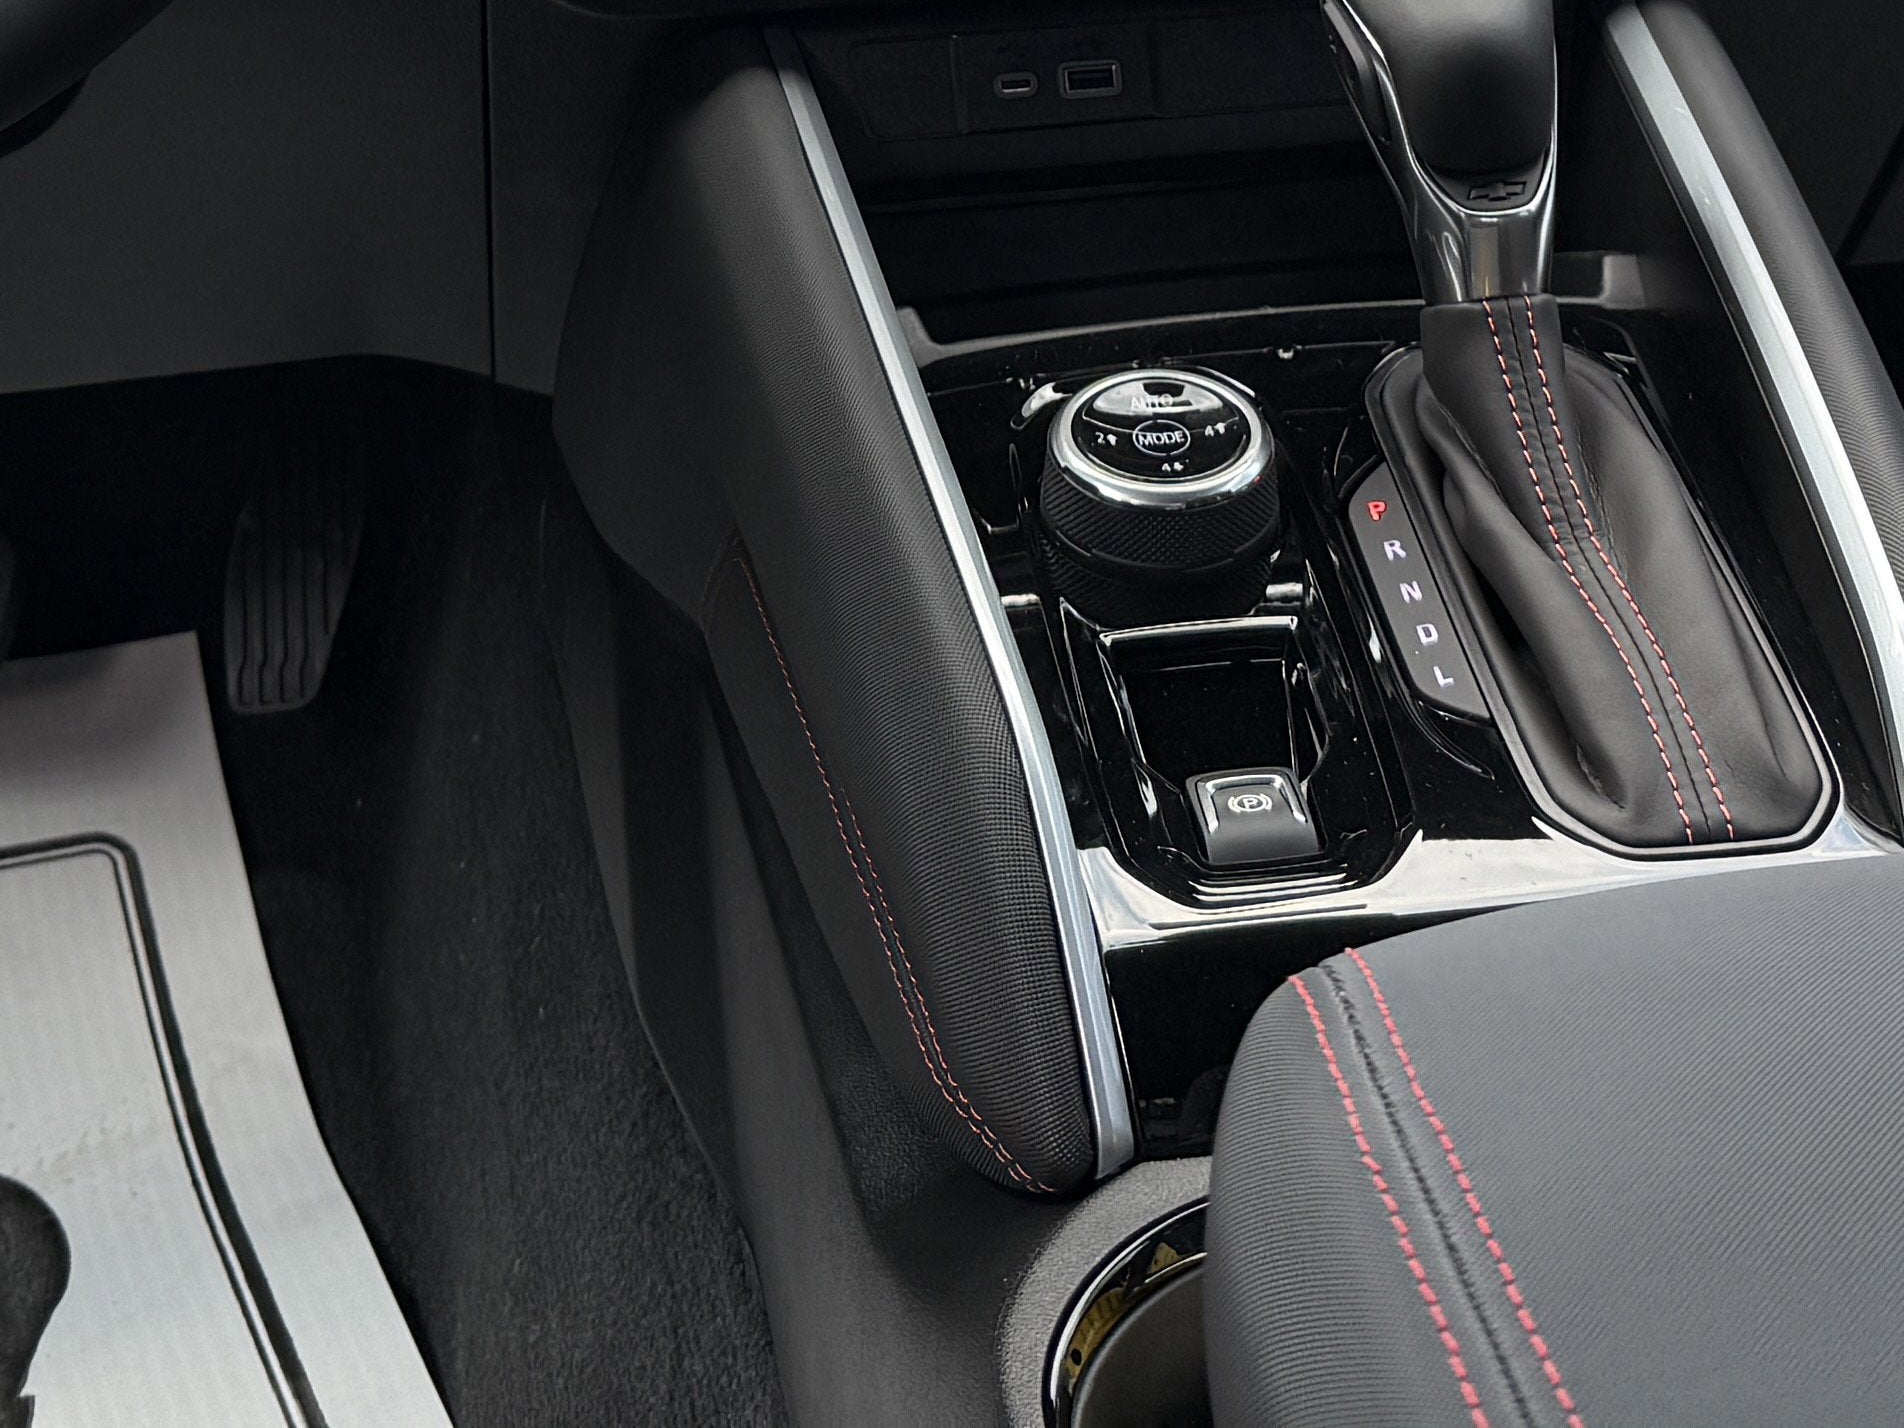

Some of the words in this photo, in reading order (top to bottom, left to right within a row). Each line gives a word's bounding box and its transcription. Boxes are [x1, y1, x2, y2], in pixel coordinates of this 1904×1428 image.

[1138, 431, 1186, 448] MODE
[1368, 500, 1385, 521] P
[1383, 539, 1407, 560] R
[1398, 581, 1423, 603] N
[1416, 623, 1440, 643] D
[1433, 666, 1454, 688] L
